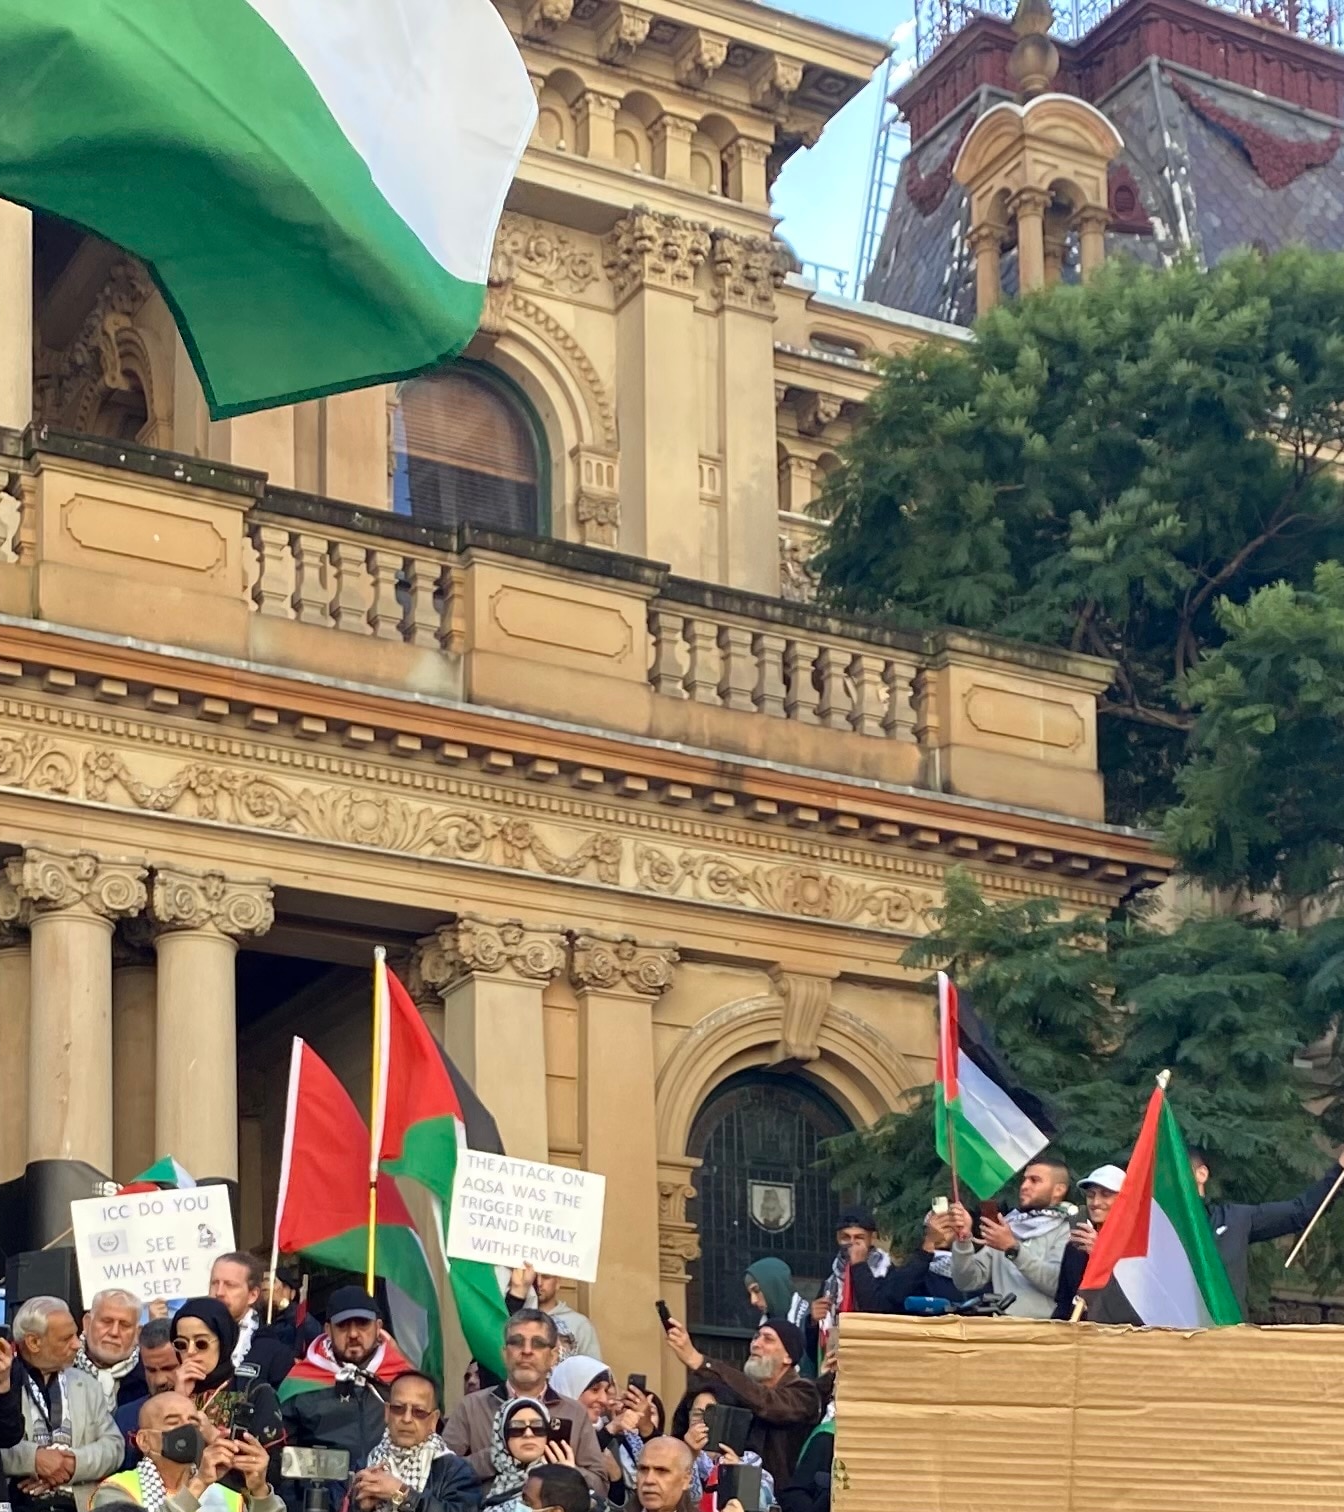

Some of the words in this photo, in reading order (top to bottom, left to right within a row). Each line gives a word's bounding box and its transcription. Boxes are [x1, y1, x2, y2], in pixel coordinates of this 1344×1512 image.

[466, 1154, 496, 1171] THE
[498, 1161, 556, 1183] ATTACK
[561, 1172, 585, 1188] ON
[461, 1176, 505, 1195] AQSA
[512, 1184, 547, 1202] WAS
[553, 1191, 583, 1209] THE
[102, 1204, 130, 1221] ICC
[138, 1200, 164, 1217] DO
[173, 1195, 209, 1213] YOU
[459, 1194, 524, 1218] TRIGGER
[528, 1207, 553, 1223] WE
[468, 1212, 519, 1233] STAND
[522, 1222, 578, 1244] FIRMLY
[145, 1236, 177, 1253] SEE
[470, 1236, 511, 1256] WITH
[511, 1243, 580, 1269] FERVOUR
[102, 1259, 156, 1280] WHAT
[162, 1256, 191, 1272] WE
[143, 1277, 182, 1296] SEE?
